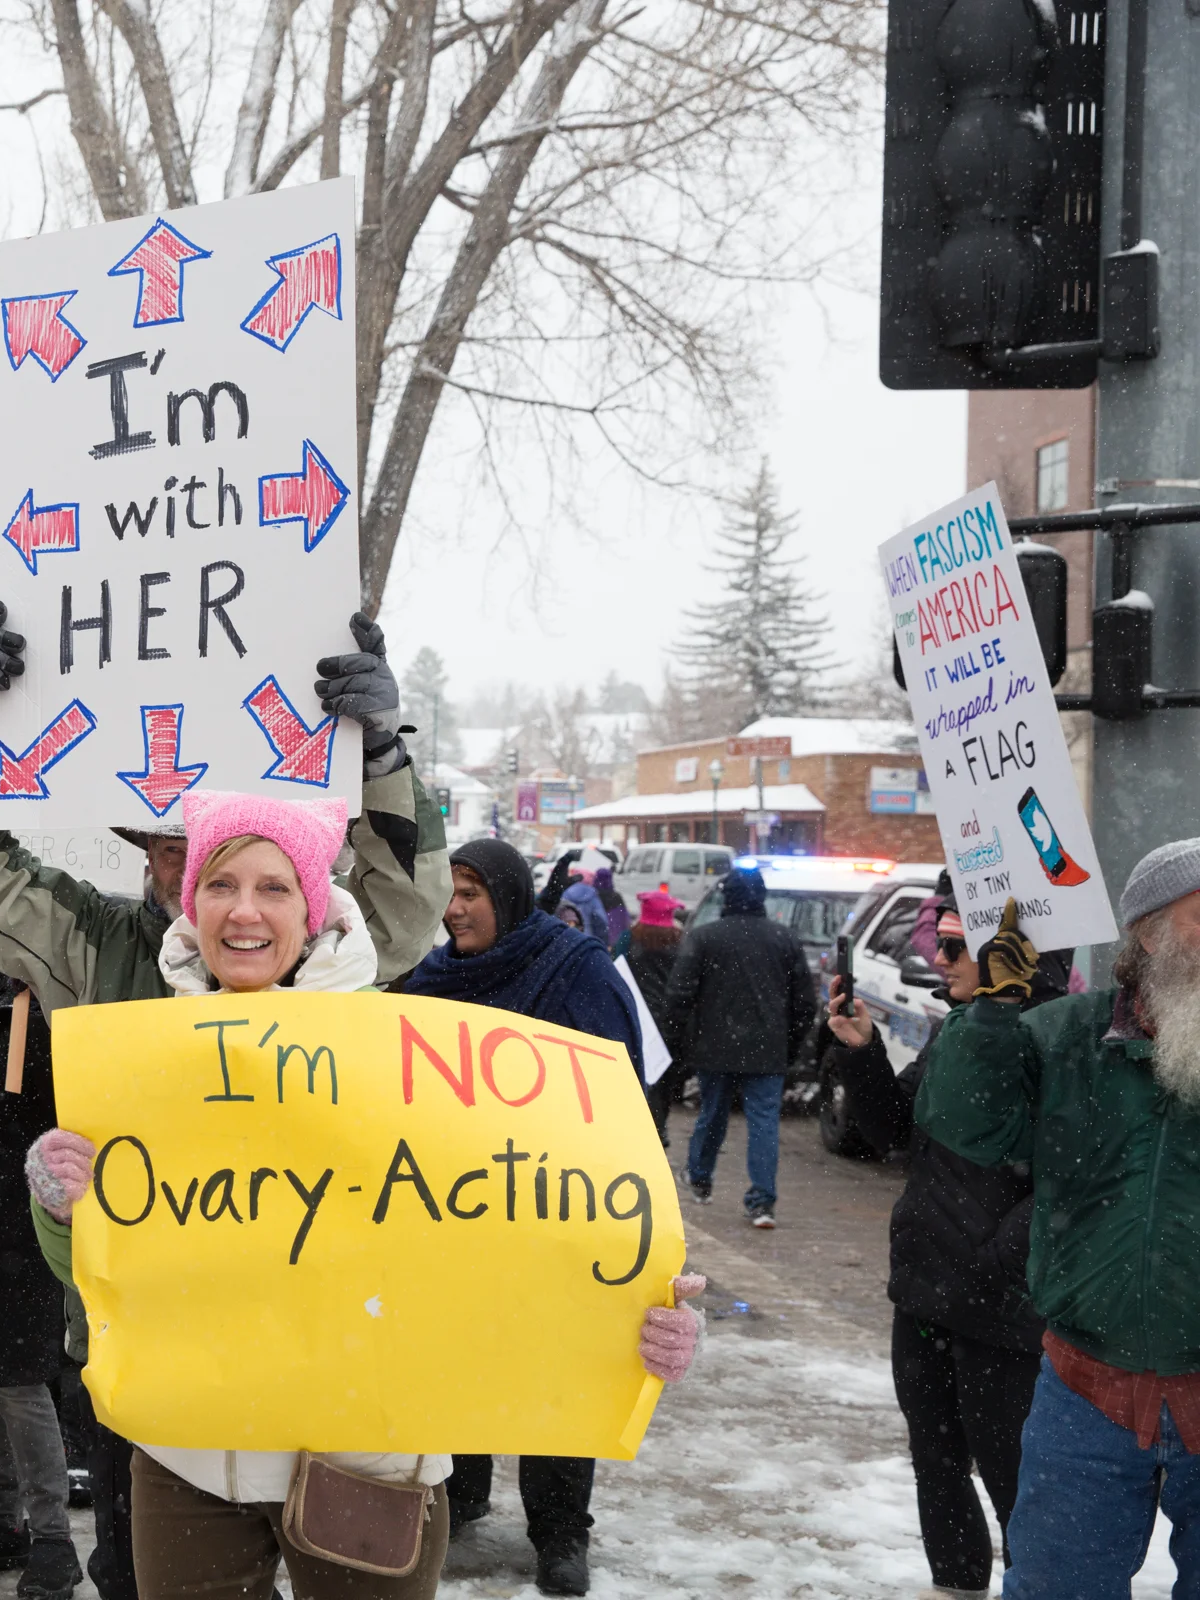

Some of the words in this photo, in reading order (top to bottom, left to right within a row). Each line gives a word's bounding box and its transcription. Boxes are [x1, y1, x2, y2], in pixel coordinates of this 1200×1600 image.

[86, 348, 249, 459] I'm
[105, 467, 243, 540] with
[885, 552, 918, 597] WHEN
[914, 501, 1003, 584] FASCISM
[60, 560, 247, 675] HER
[905, 632, 915, 648] to
[917, 564, 1020, 655] AMERICA
[925, 667, 938, 692] IT
[944, 651, 981, 684] WILL
[981, 637, 1006, 669] BE
[925, 676, 998, 740] wrapped
[1005, 670, 1036, 705] in
[945, 759, 957, 779] A
[962, 721, 1036, 786] FLAG
[953, 826, 1004, 875] tweeted
[960, 808, 981, 838] and
[965, 881, 979, 901] BY
[984, 871, 1012, 896] TINY
[194, 1018, 338, 1105] I'm
[399, 1014, 617, 1124] NOT
[92, 1135, 653, 1286] Ovary-Acting
